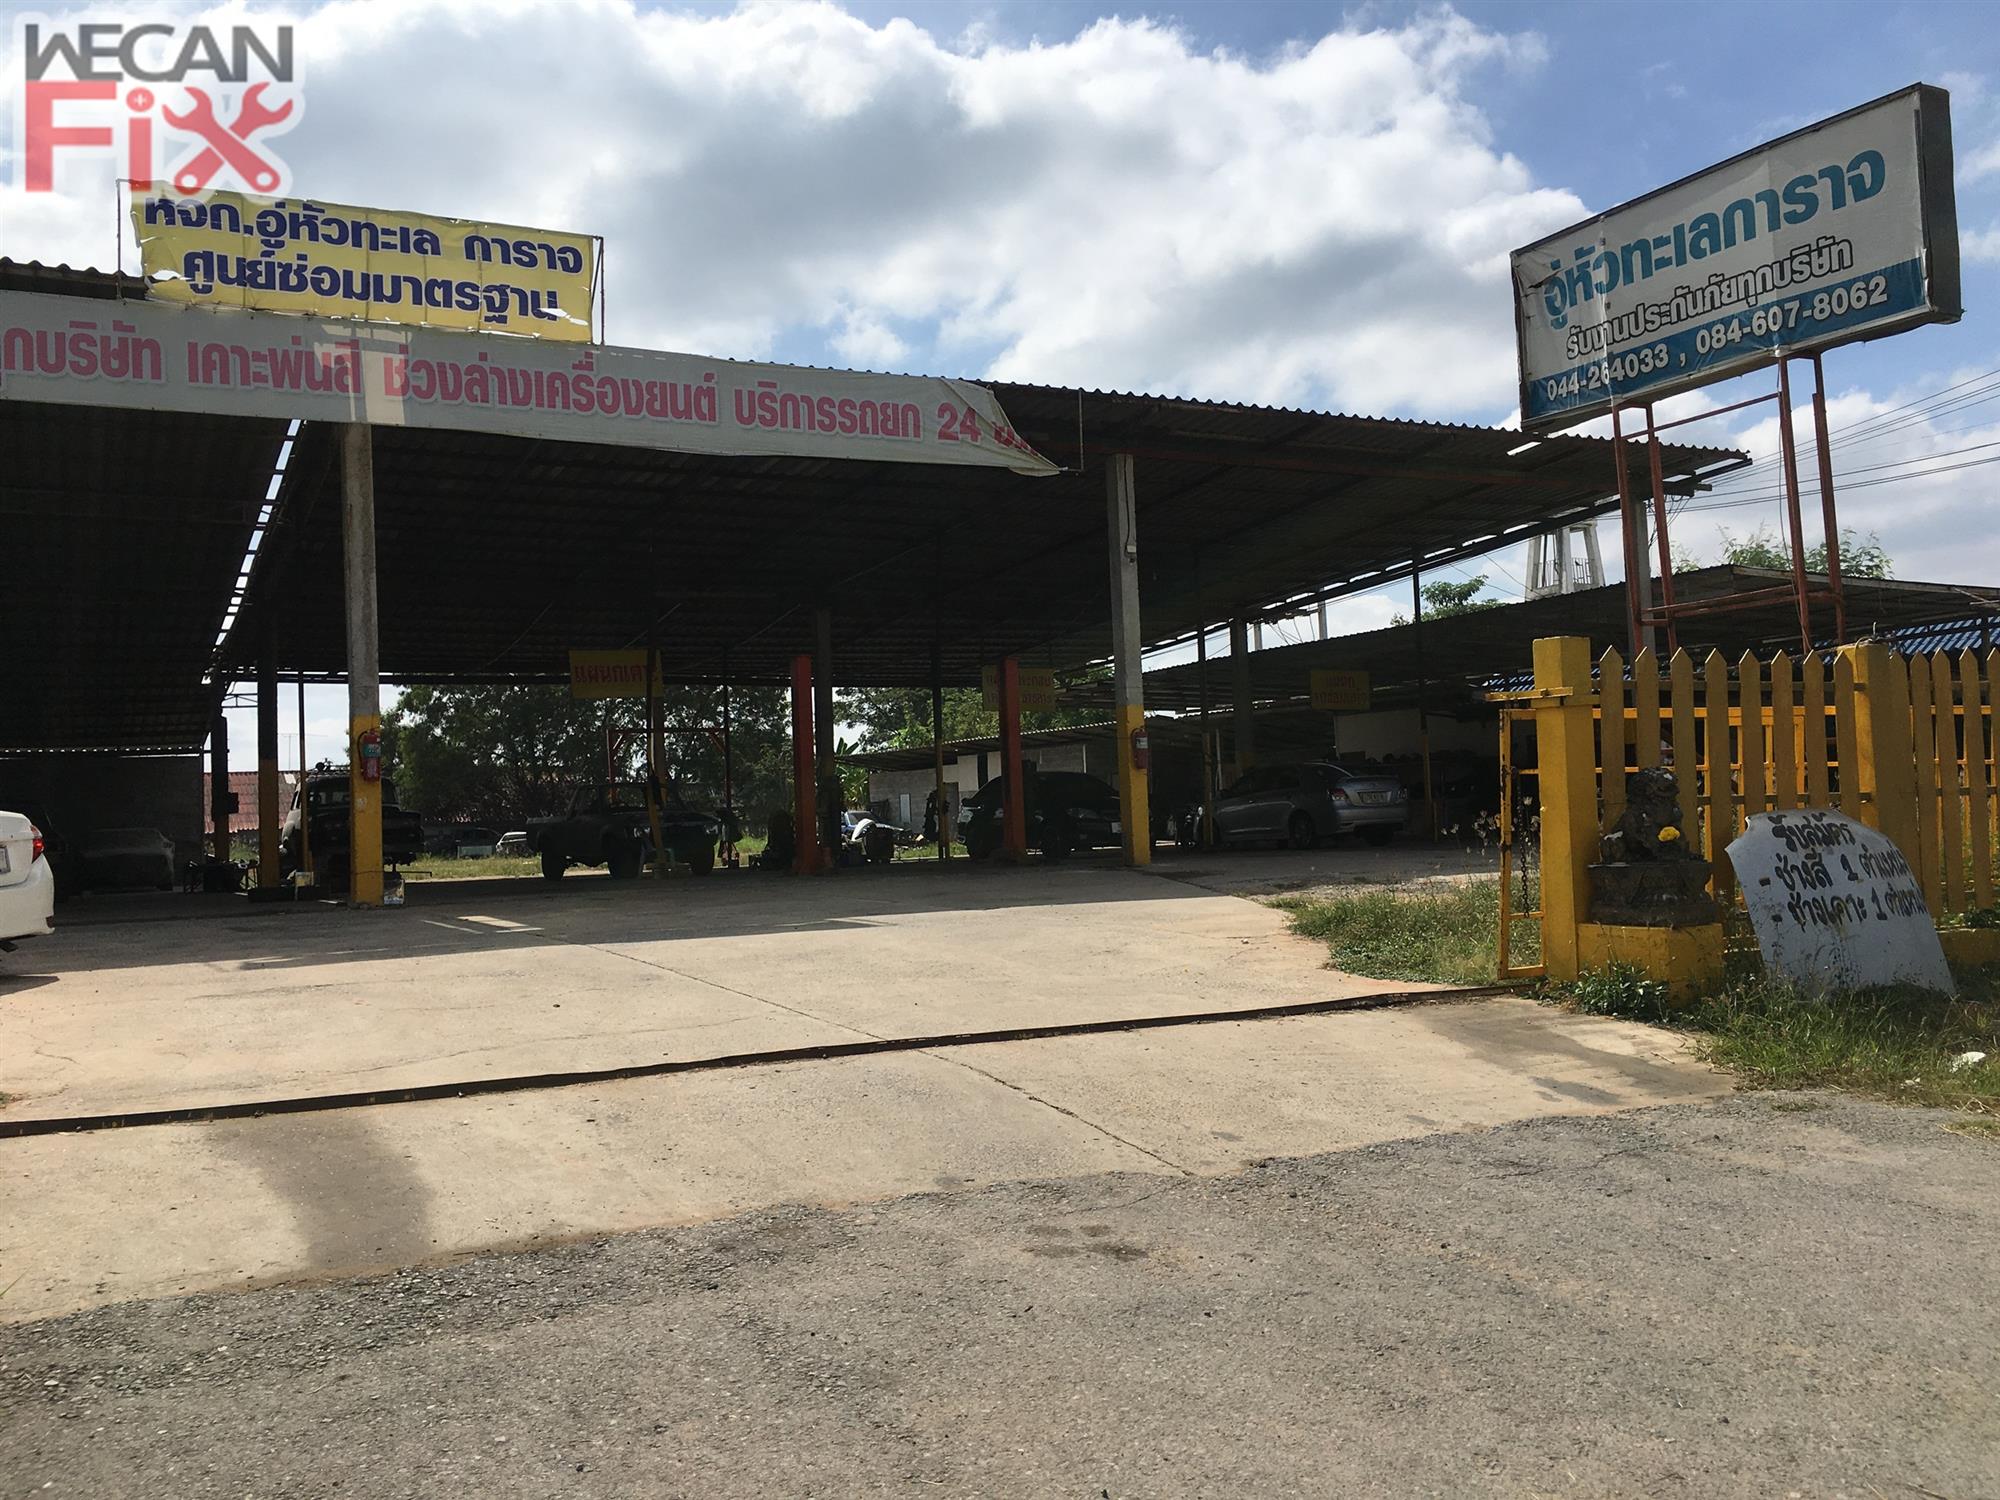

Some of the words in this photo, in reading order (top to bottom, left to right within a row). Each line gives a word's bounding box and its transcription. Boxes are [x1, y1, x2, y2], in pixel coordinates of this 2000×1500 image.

[144, 196, 441, 255] หจก.อู่หัวทะเล
[465, 234, 584, 274] การาจ
[1544, 149, 1886, 329] อู่หัวทะเลการาจ
[184, 248, 558, 324] ศูนย์ซ่อมมาตรฐาน
[1547, 343, 1669, 402] 044-264033
[1695, 276, 1888, 355] 084-607-8062
[188, 335, 362, 393] เคาะพ่นสี
[383, 343, 717, 421] ช่วงล่างเครื่องยนต์
[734, 381, 921, 438] บริการรถยก
[938, 403, 981, 442] 24
[1840, 853, 1858, 882] 1
[1871, 887, 1888, 921] 1
